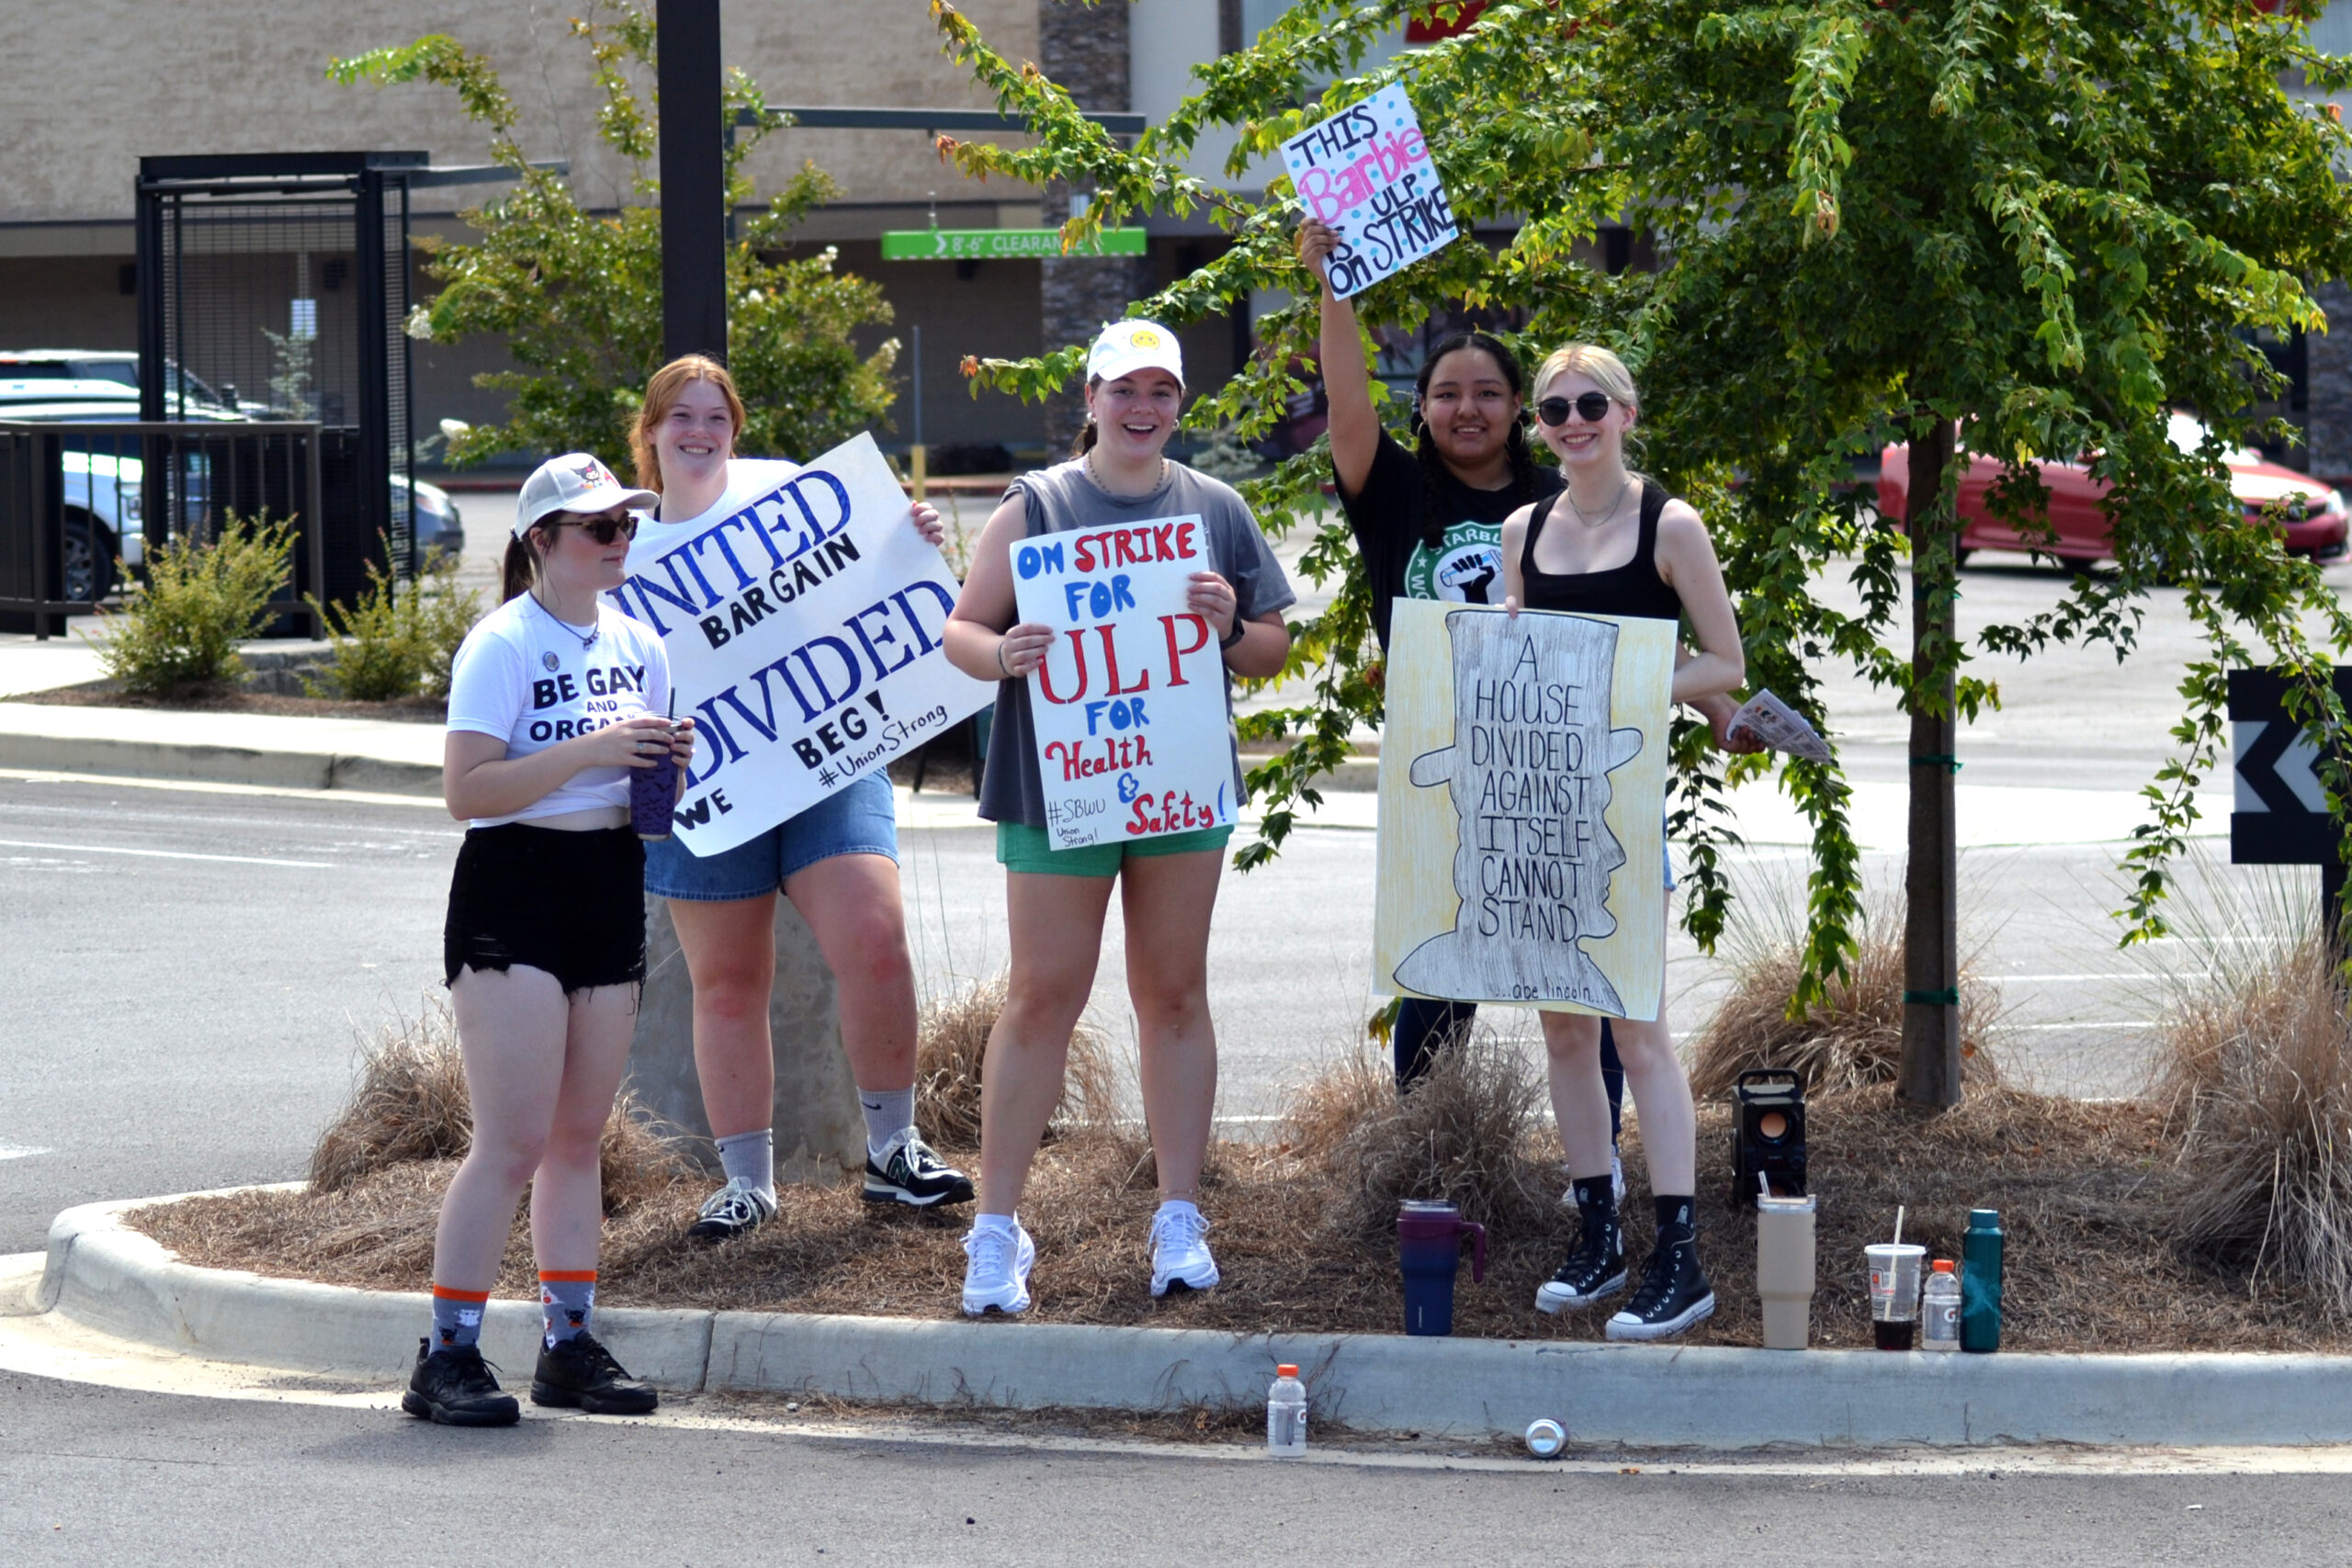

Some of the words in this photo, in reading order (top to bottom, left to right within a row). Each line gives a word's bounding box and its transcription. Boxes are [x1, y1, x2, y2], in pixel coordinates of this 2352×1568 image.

[1289, 105, 1378, 167] THIS
[1297, 128, 1429, 224] Barbie
[1370, 174, 1417, 217] ULP
[1329, 254, 1373, 294] On
[1363, 185, 1455, 271] STRIKE
[1017, 541, 1064, 580] ON
[1074, 523, 1197, 572] STRIKE
[699, 532, 861, 650] BARGAIN
[1064, 574, 1136, 622] FOR
[1038, 613, 1209, 705] ULP
[1511, 634, 1538, 682] A
[532, 673, 580, 710] BE
[585, 665, 645, 696] GAY
[586, 700, 617, 713] AND
[1476, 679, 1585, 727] HOUSE
[1084, 697, 1150, 736] FOR
[1045, 735, 1153, 782] Health
[1472, 726, 1584, 772] DIVIDED
[673, 788, 733, 830] WE
[1117, 772, 1139, 804] &
[1479, 770, 1591, 816] AGAINST
[1057, 827, 1080, 838] Union
[1064, 829, 1100, 848] Strong!
[1479, 815, 1591, 858] ITSELF
[1481, 855, 1586, 900] CANNOT
[1478, 897, 1578, 943] STAND
